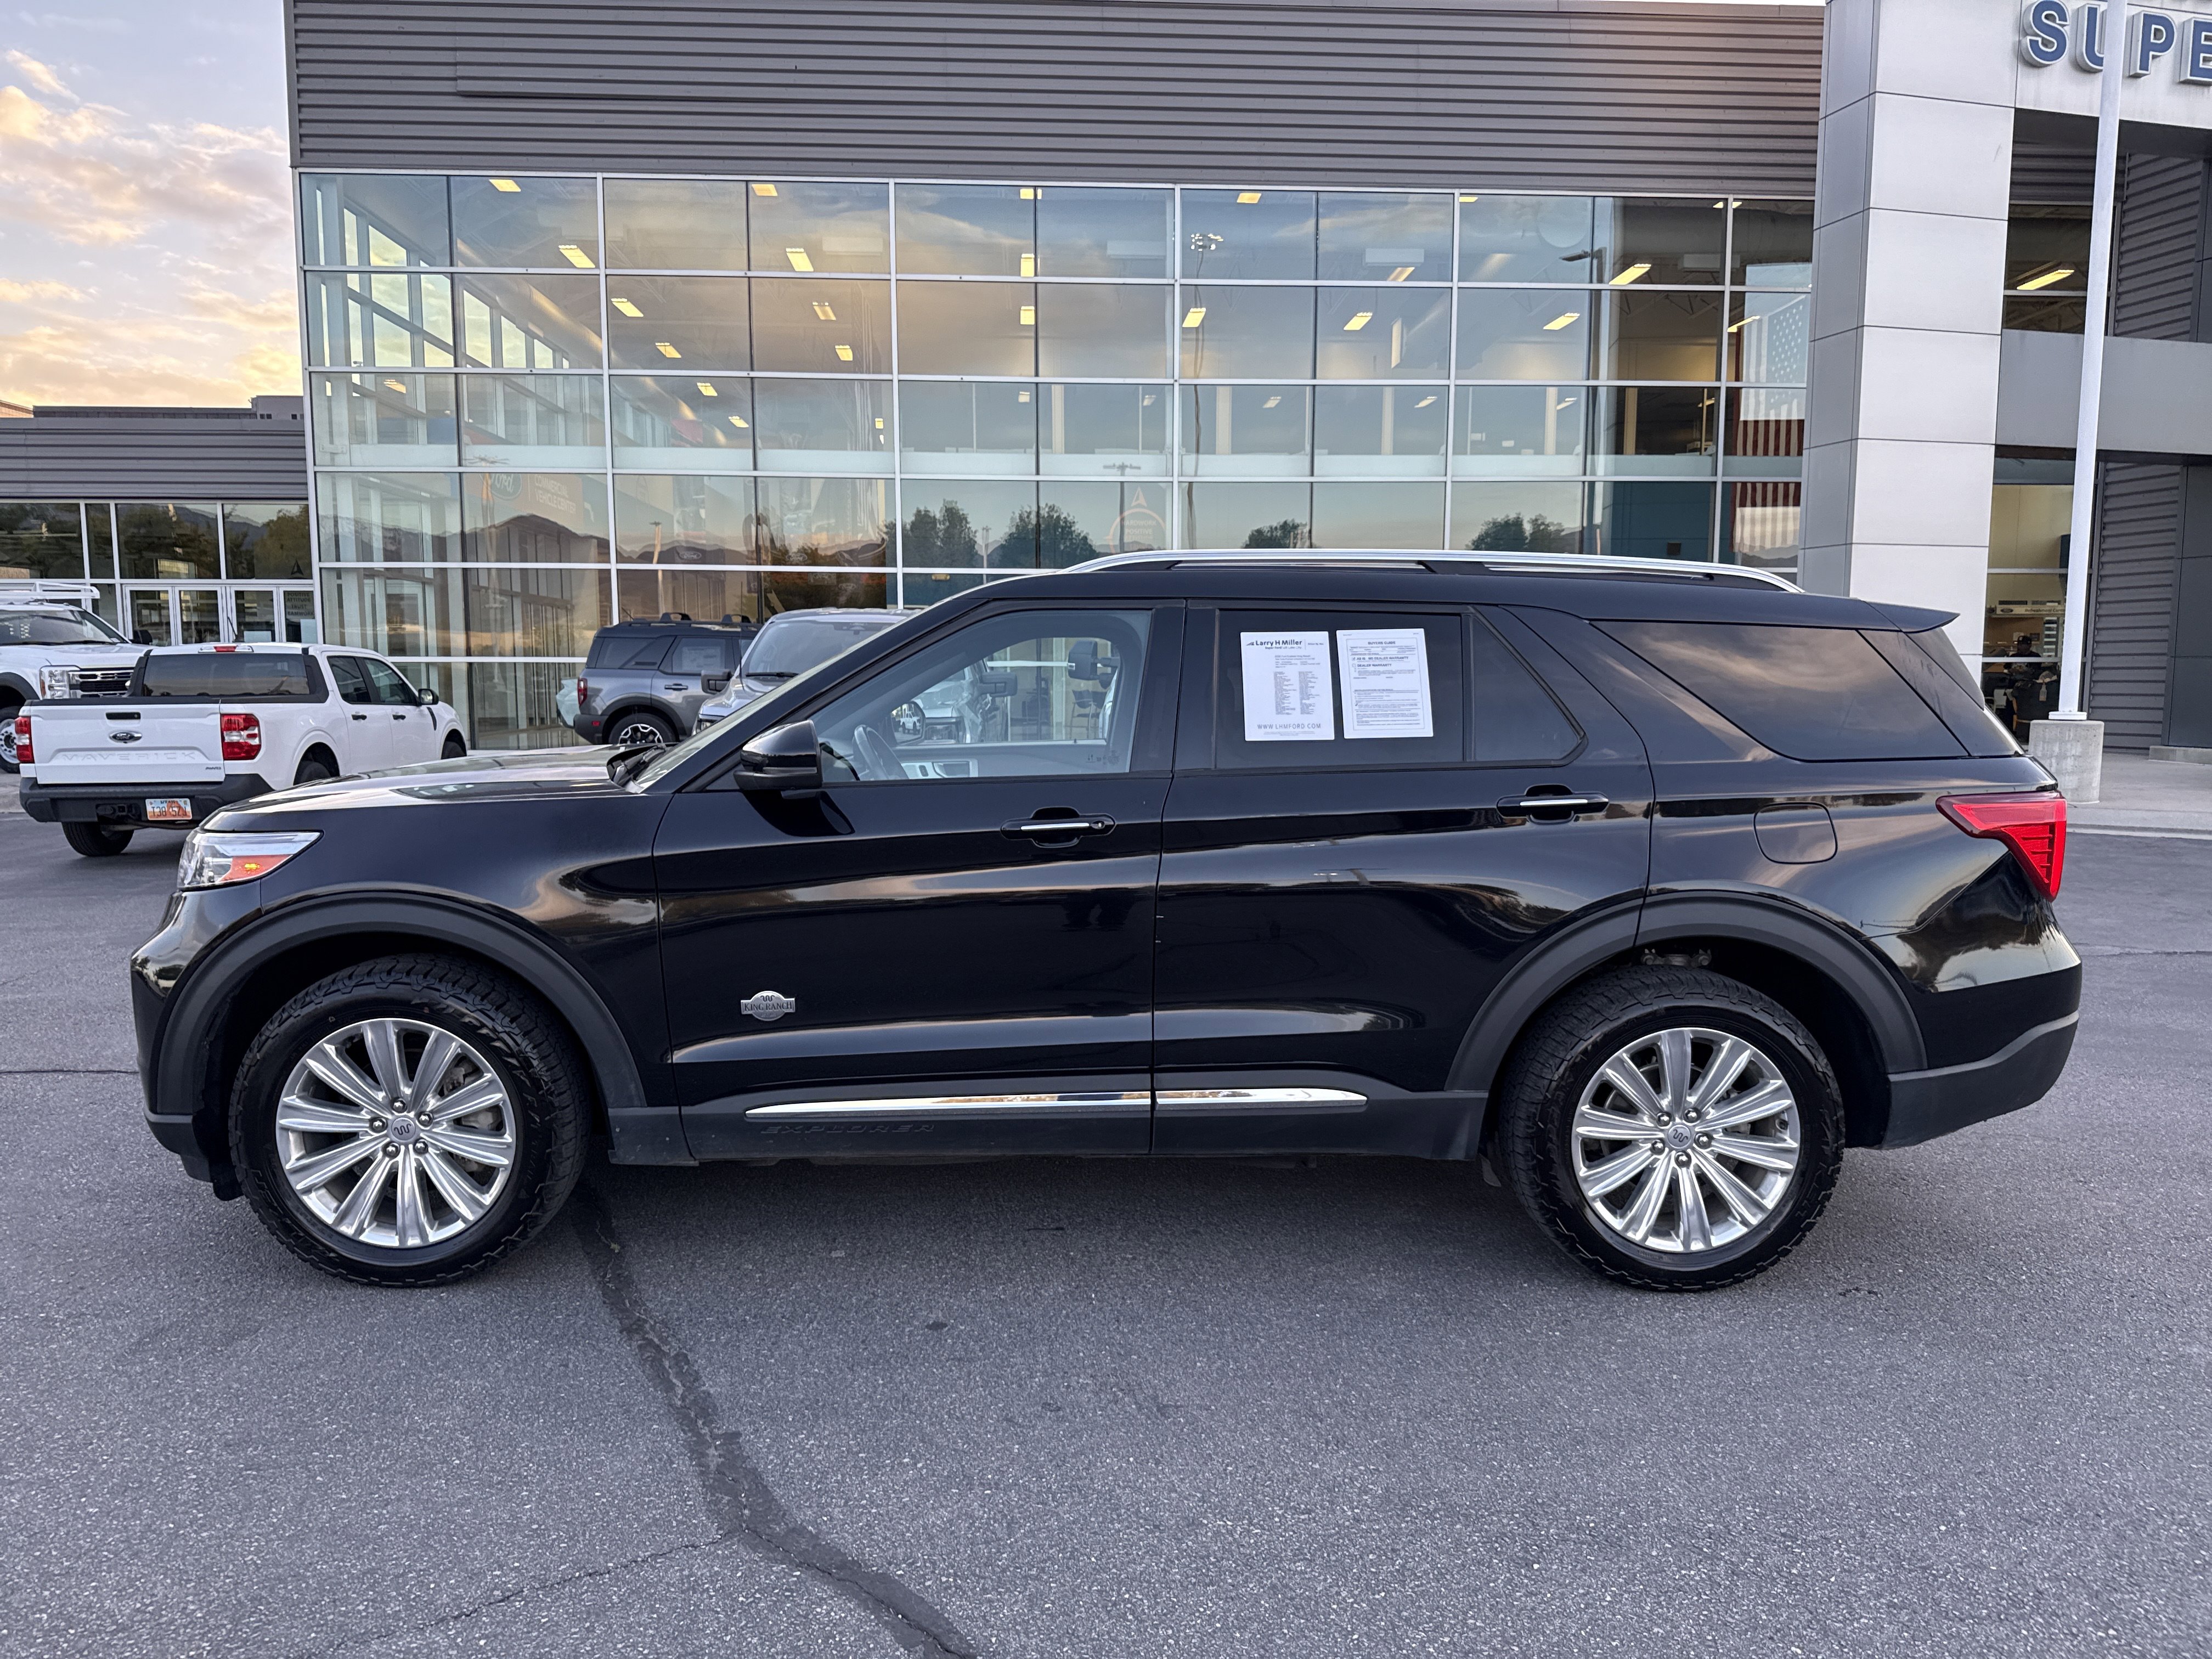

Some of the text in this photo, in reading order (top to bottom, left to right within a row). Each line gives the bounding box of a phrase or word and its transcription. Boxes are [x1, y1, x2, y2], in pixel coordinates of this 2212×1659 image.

[2021, 0, 2212, 86] SUPE
[63, 752, 196, 761] MAVERICK
[744, 1001, 792, 1012] KING RANCH
[760, 1125, 935, 1134] EXPLORER
